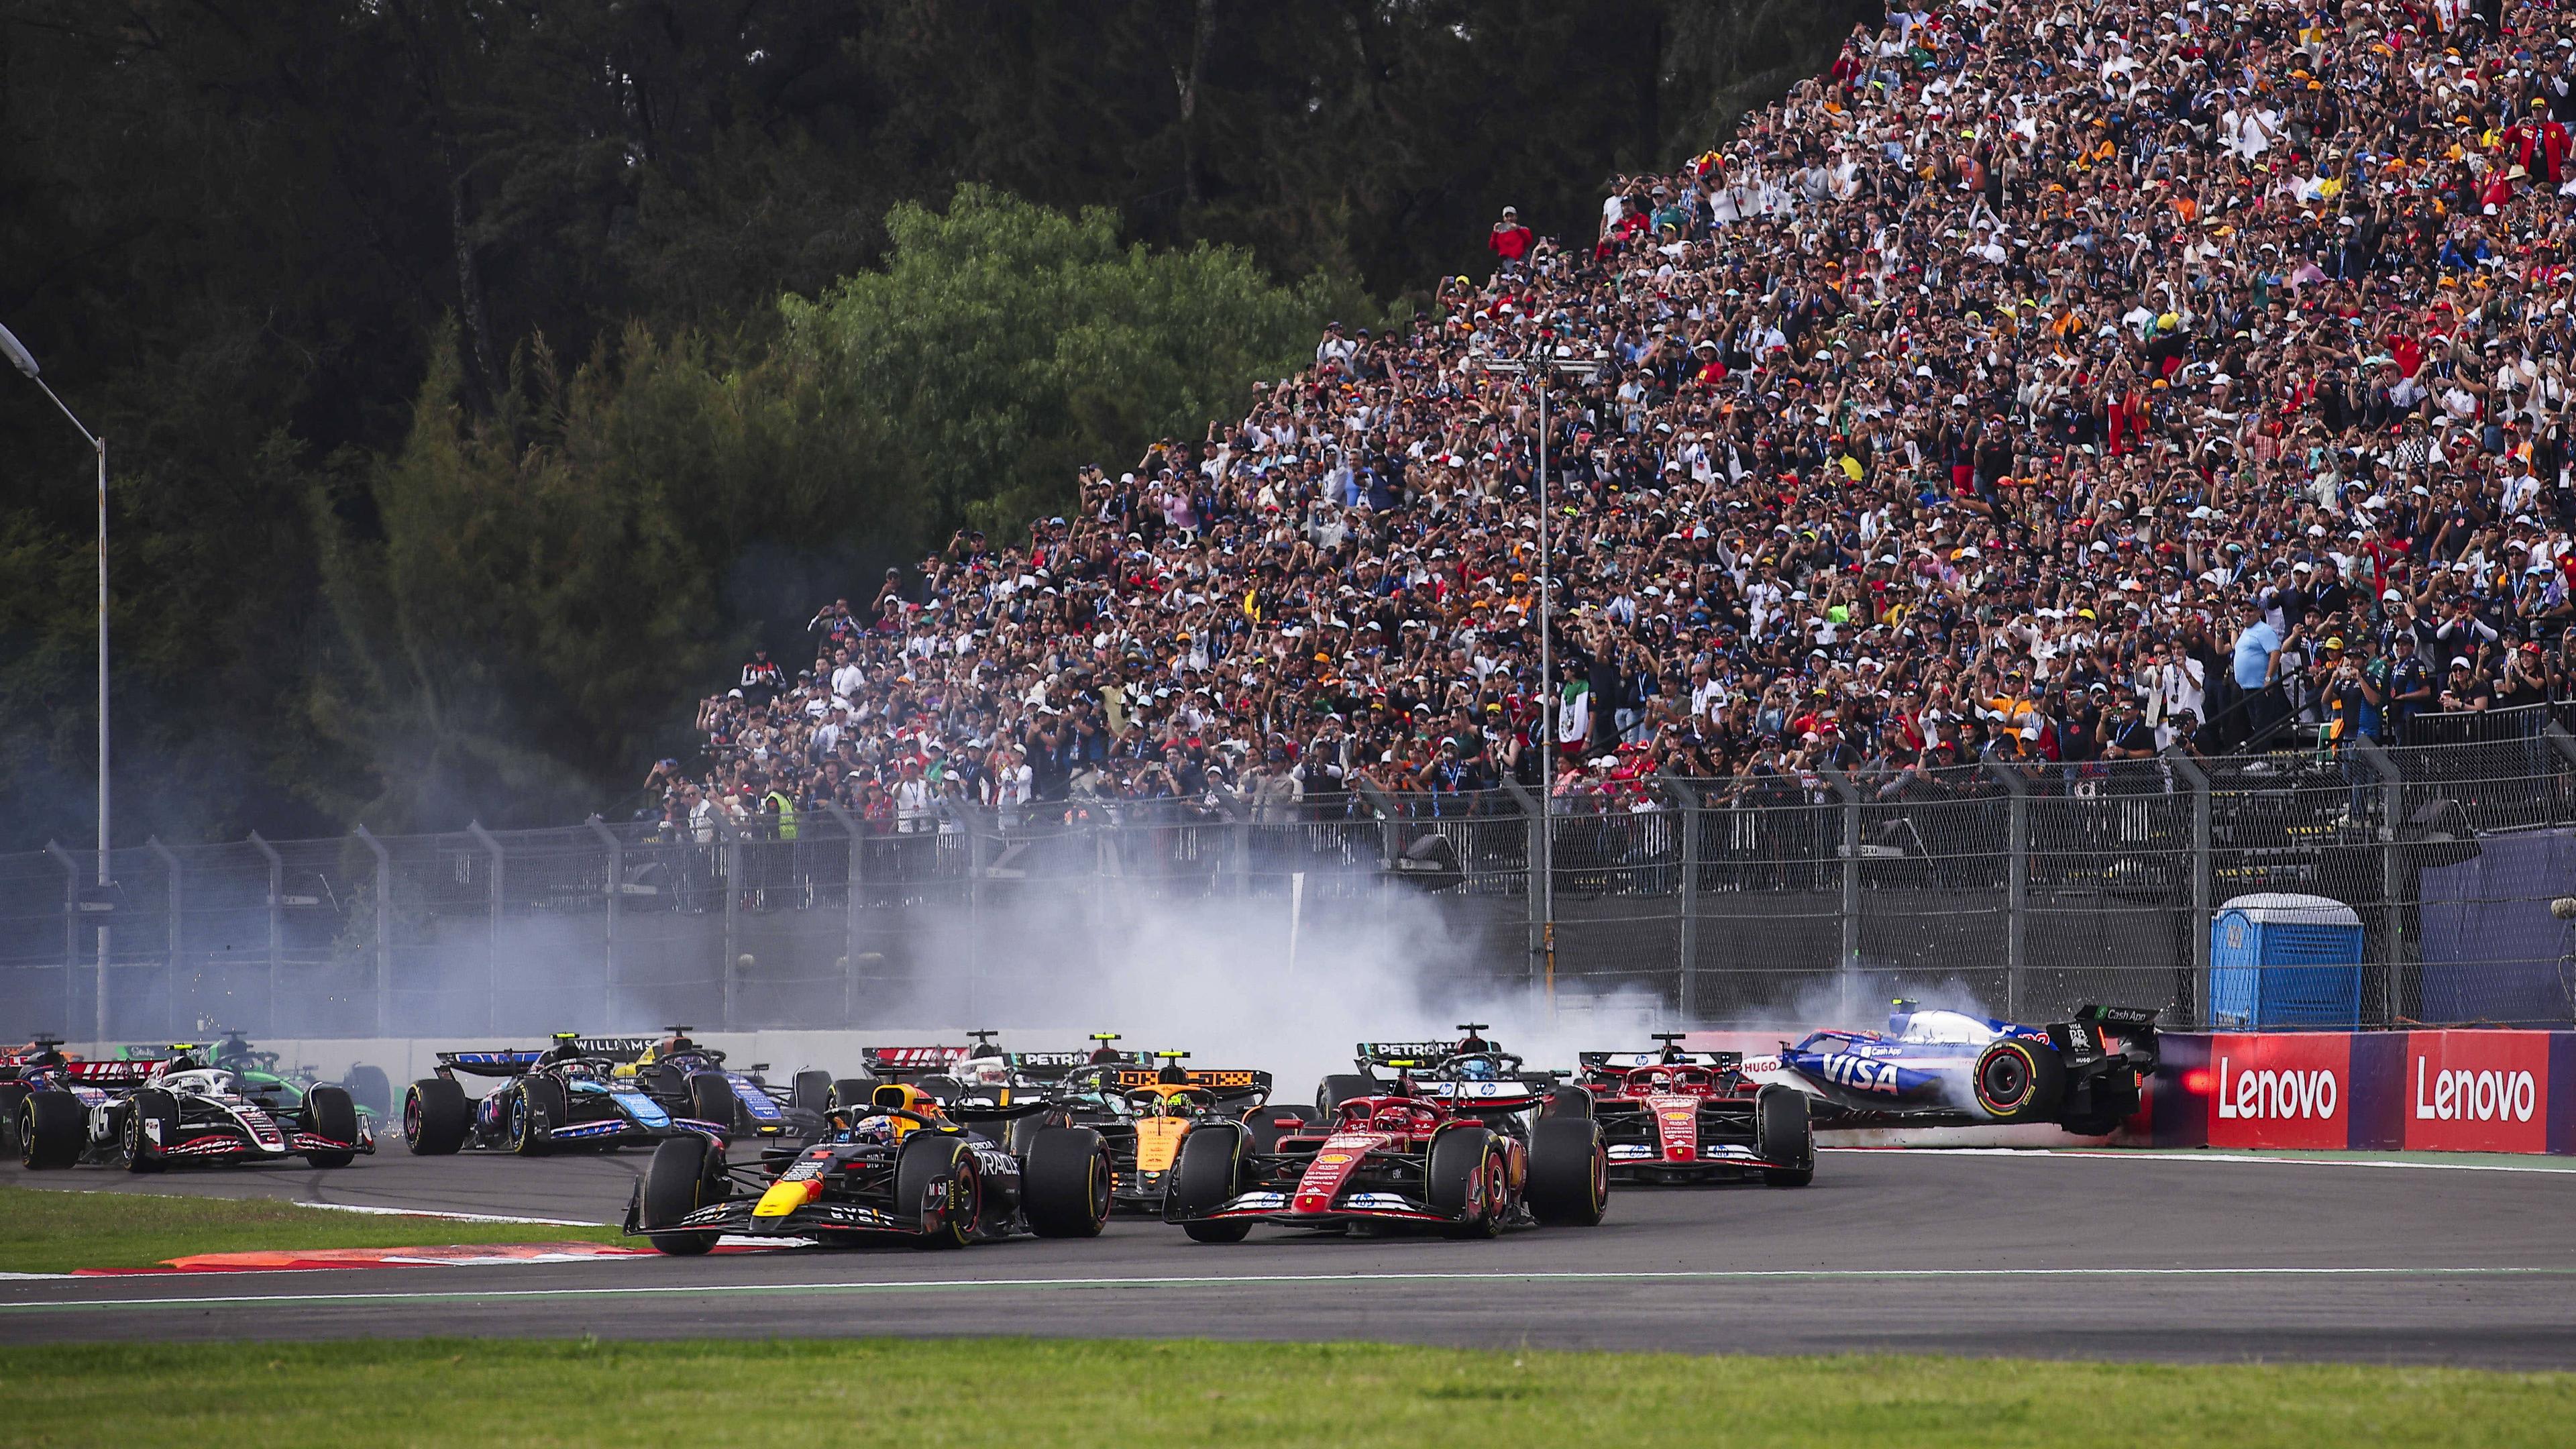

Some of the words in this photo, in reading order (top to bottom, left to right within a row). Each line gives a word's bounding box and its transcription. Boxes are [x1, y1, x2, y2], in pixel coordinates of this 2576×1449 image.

[2108, 1009, 2128, 1020] Cash
[2130, 1011, 2146, 1022] App
[1872, 1047, 1888, 1056] Cash
[1888, 1047, 1902, 1057] App
[1744, 1061, 1776, 1073] HUGO
[1823, 1053, 1898, 1096] VISA
[1481, 1083, 1496, 1096] hp
[2218, 1056, 2337, 1120] Lenovo
[2416, 1055, 2536, 1123] Lenovo
[928, 1182, 947, 1196] Mobil
